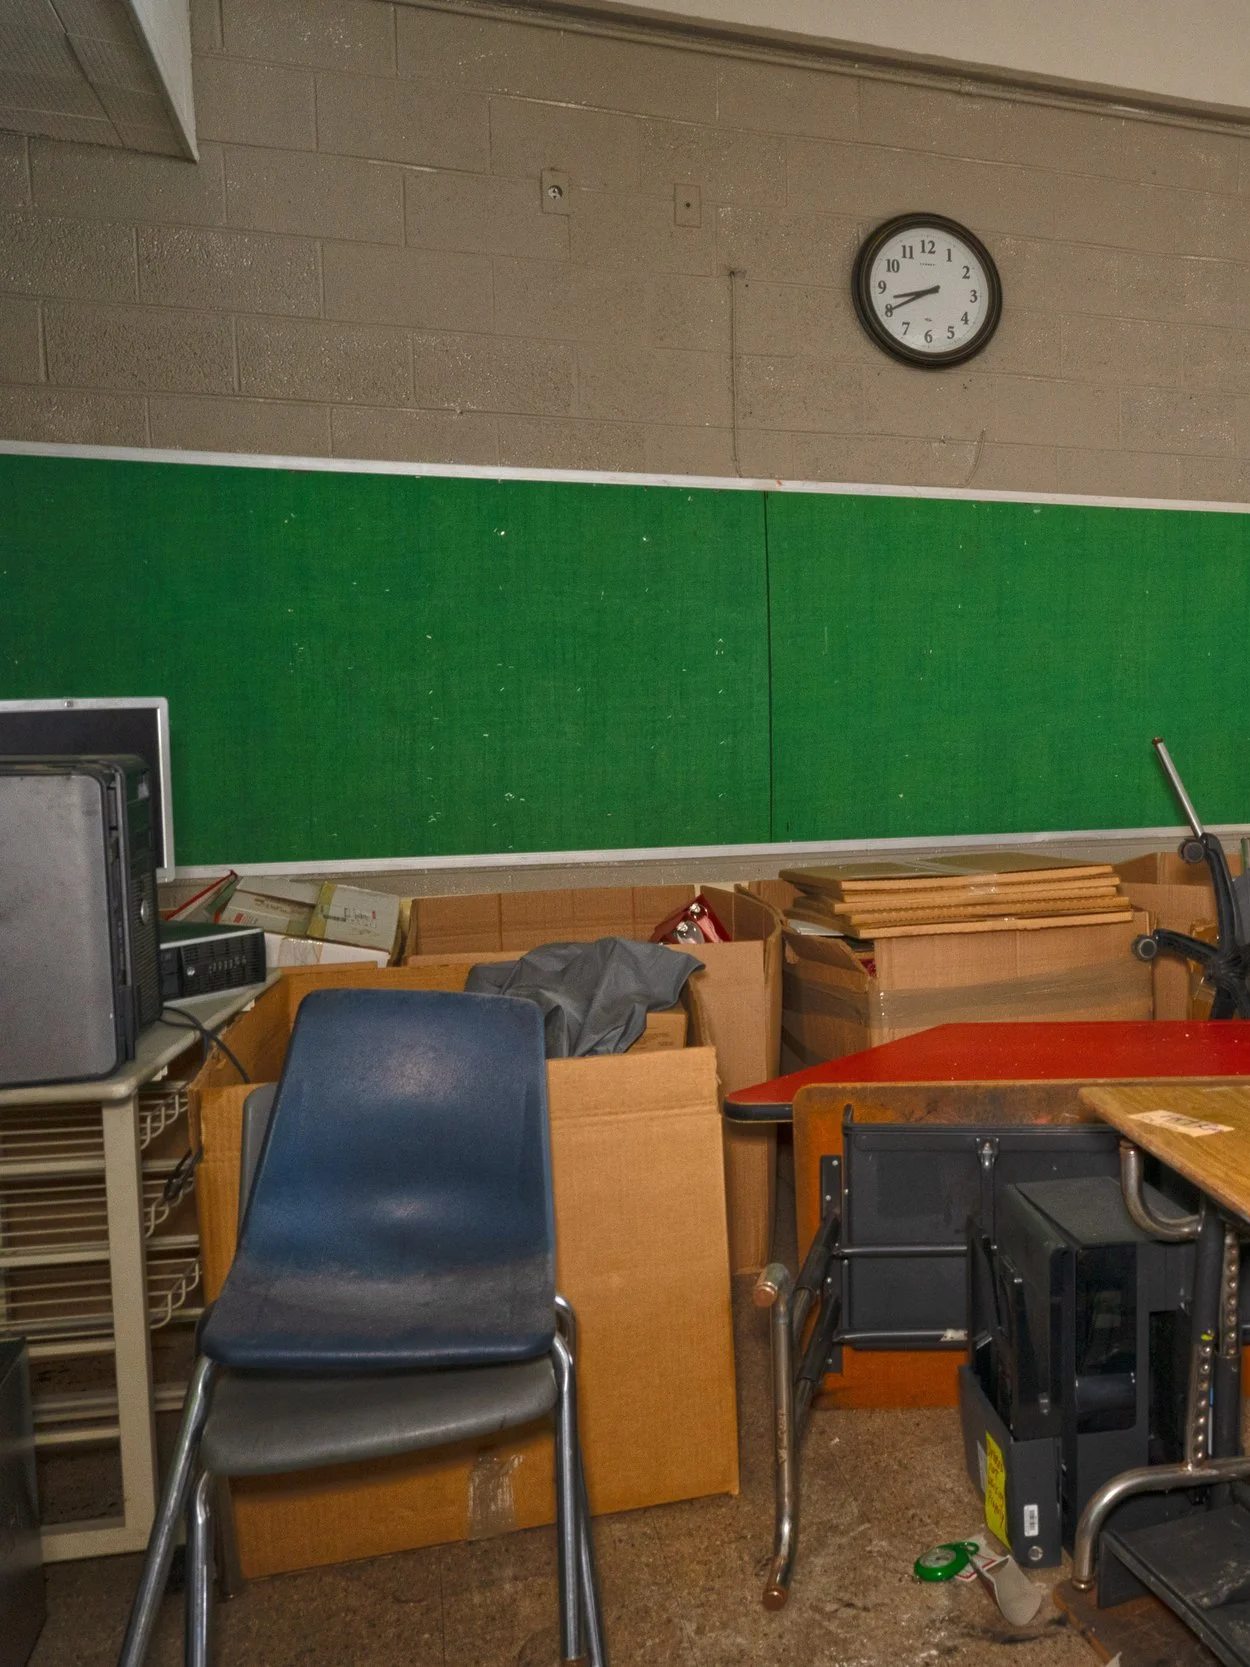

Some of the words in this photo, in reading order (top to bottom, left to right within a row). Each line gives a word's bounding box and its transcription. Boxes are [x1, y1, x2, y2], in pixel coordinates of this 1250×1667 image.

[901, 245, 914, 259] 11
[920, 240, 935, 254] 12
[946, 249, 953, 262] 1
[886, 259, 900, 273] 10
[961, 266, 970, 279] 2
[877, 280, 886, 294] 9
[969, 289, 977, 303] 3
[884, 304, 893, 317] 8
[960, 312, 969, 325] 4
[901, 322, 910, 335] 7
[946, 326, 954, 339] 5
[923, 330, 932, 343] 6
